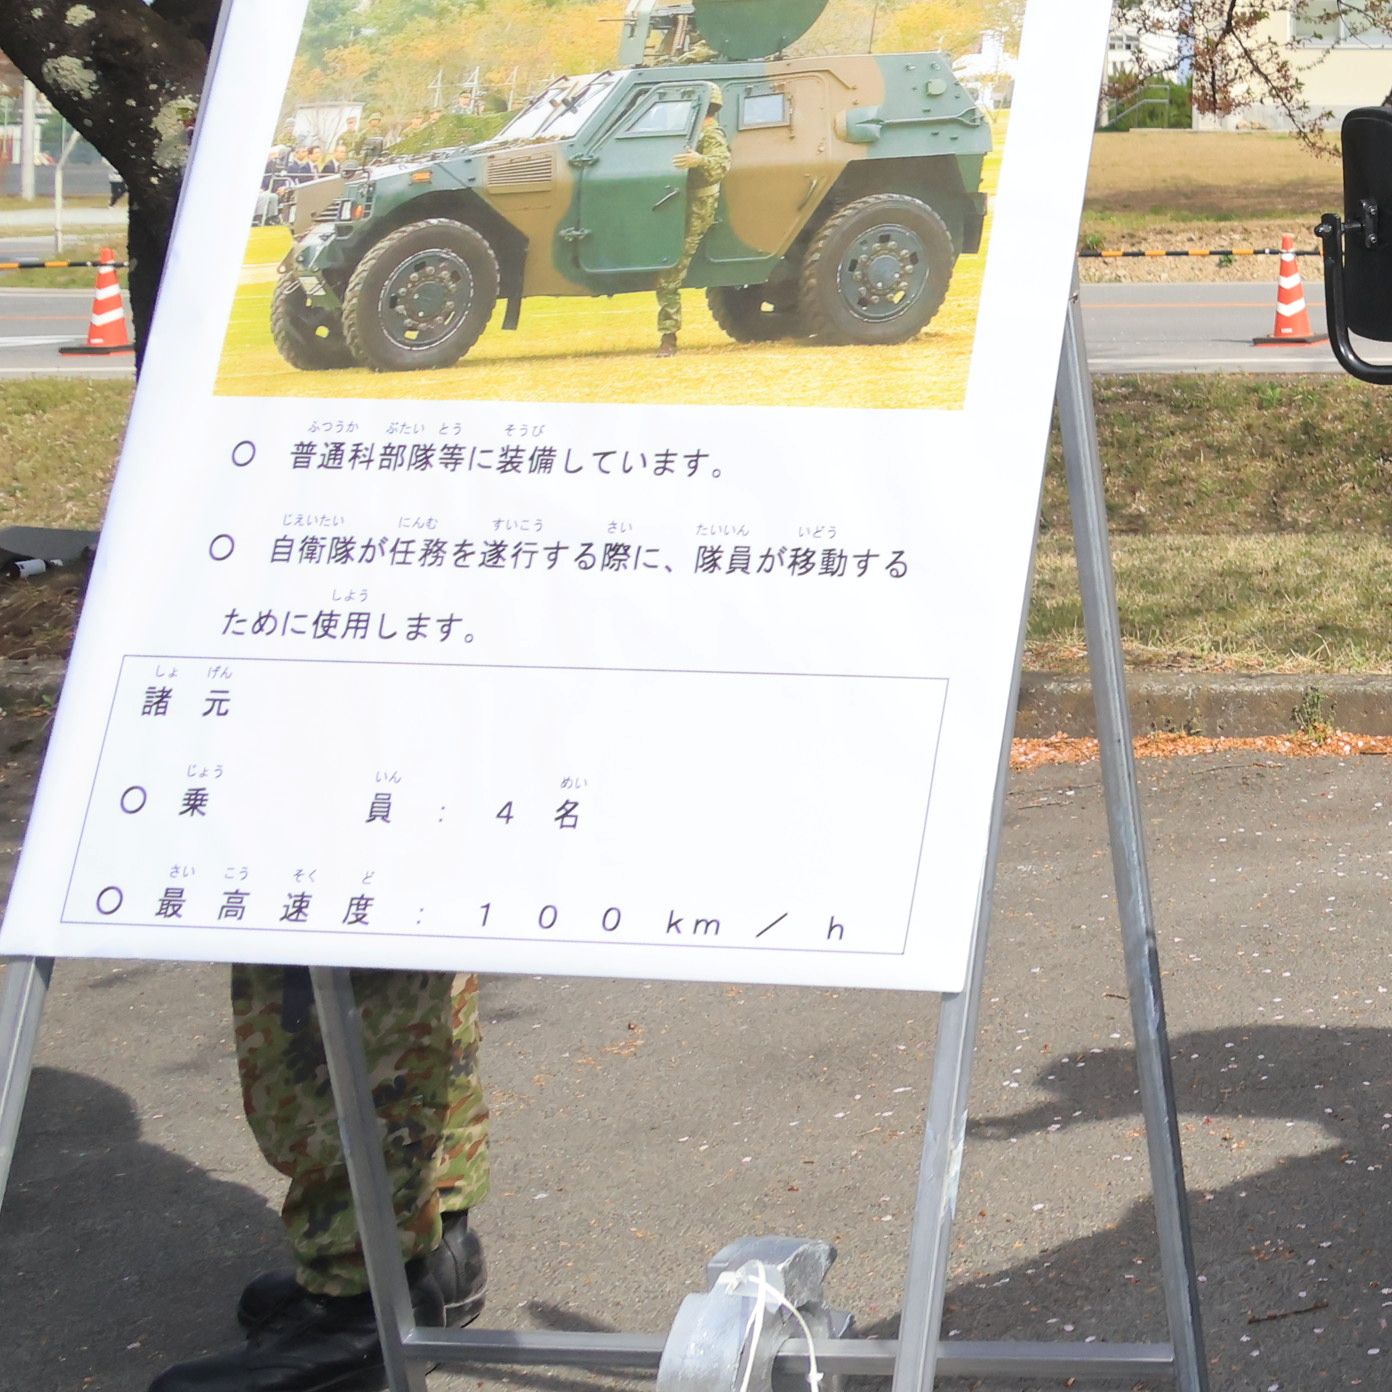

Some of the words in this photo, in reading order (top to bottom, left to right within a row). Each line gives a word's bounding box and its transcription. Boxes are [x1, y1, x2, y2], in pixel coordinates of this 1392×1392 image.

[291, 441, 721, 478] 普通科部隊等に装備しています。
[270, 534, 908, 579] 自衛隊が任務を遂行する際に、隊員が移動する
[222, 608, 473, 643] ために使用します。
